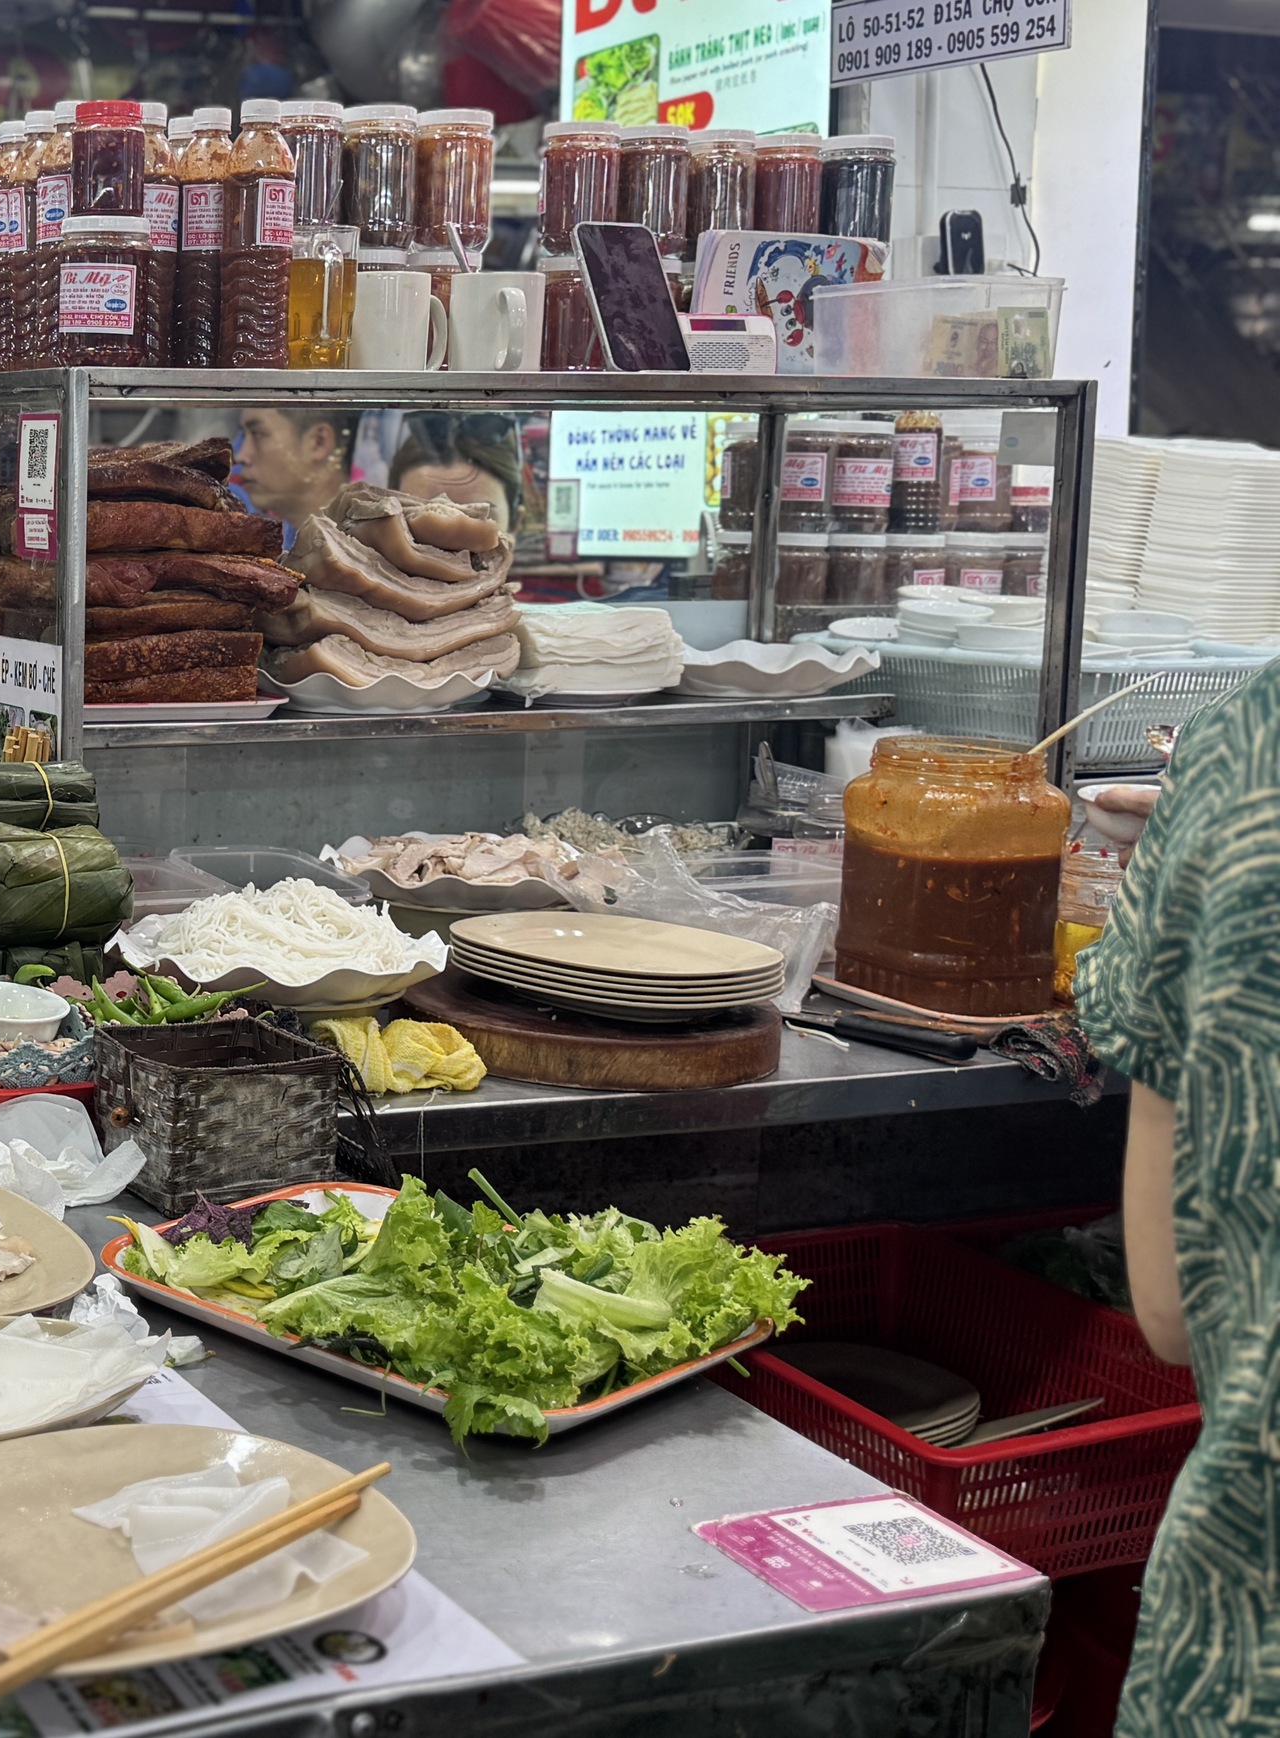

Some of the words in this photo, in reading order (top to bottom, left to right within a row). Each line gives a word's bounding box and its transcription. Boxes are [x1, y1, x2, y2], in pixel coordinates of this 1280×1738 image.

[838, 16, 855, 43] LÔ
[863, 7, 925, 38] 50-51-52
[933, 0, 973, 25] Đ15A
[838, 50, 870, 73] 0901
[875, 45, 901, 66] 909
[907, 37, 933, 61] 189
[947, 28, 985, 54] 0905
[990, 21, 1020, 47] 599
[1025, 15, 1056, 41] 254
[723, 243, 741, 296] FRIENDS
[1, 652, 10, 684] ÉP
[14, 660, 27, 688] KEM
[42, 660, 55, 694] CHÈ
